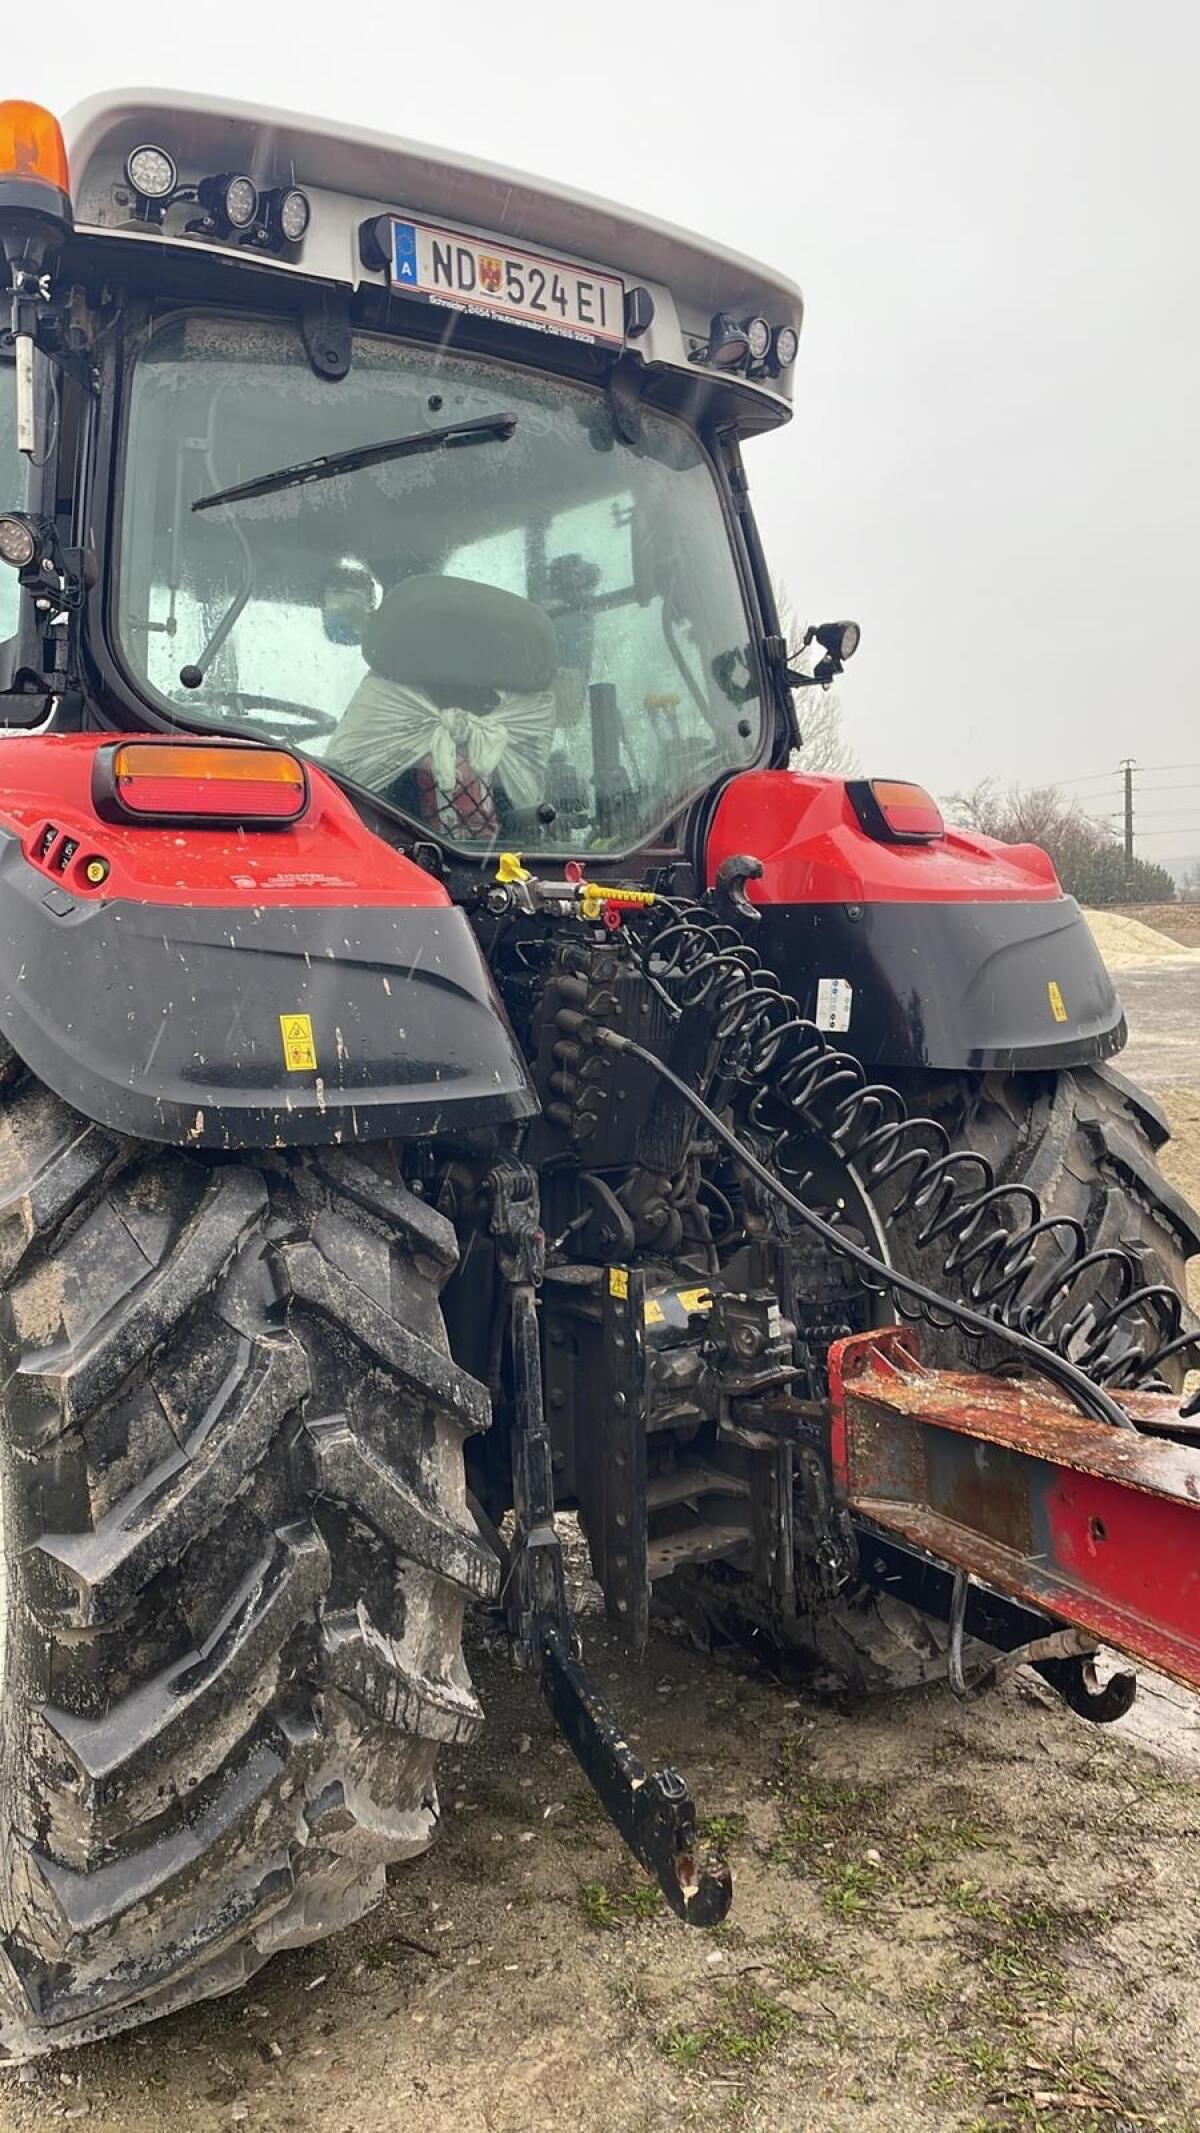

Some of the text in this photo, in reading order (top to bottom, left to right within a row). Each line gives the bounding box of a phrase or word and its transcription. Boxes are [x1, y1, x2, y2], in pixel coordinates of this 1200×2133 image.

[401, 261, 413, 276] A
[432, 240, 605, 328] ND 524 EI
